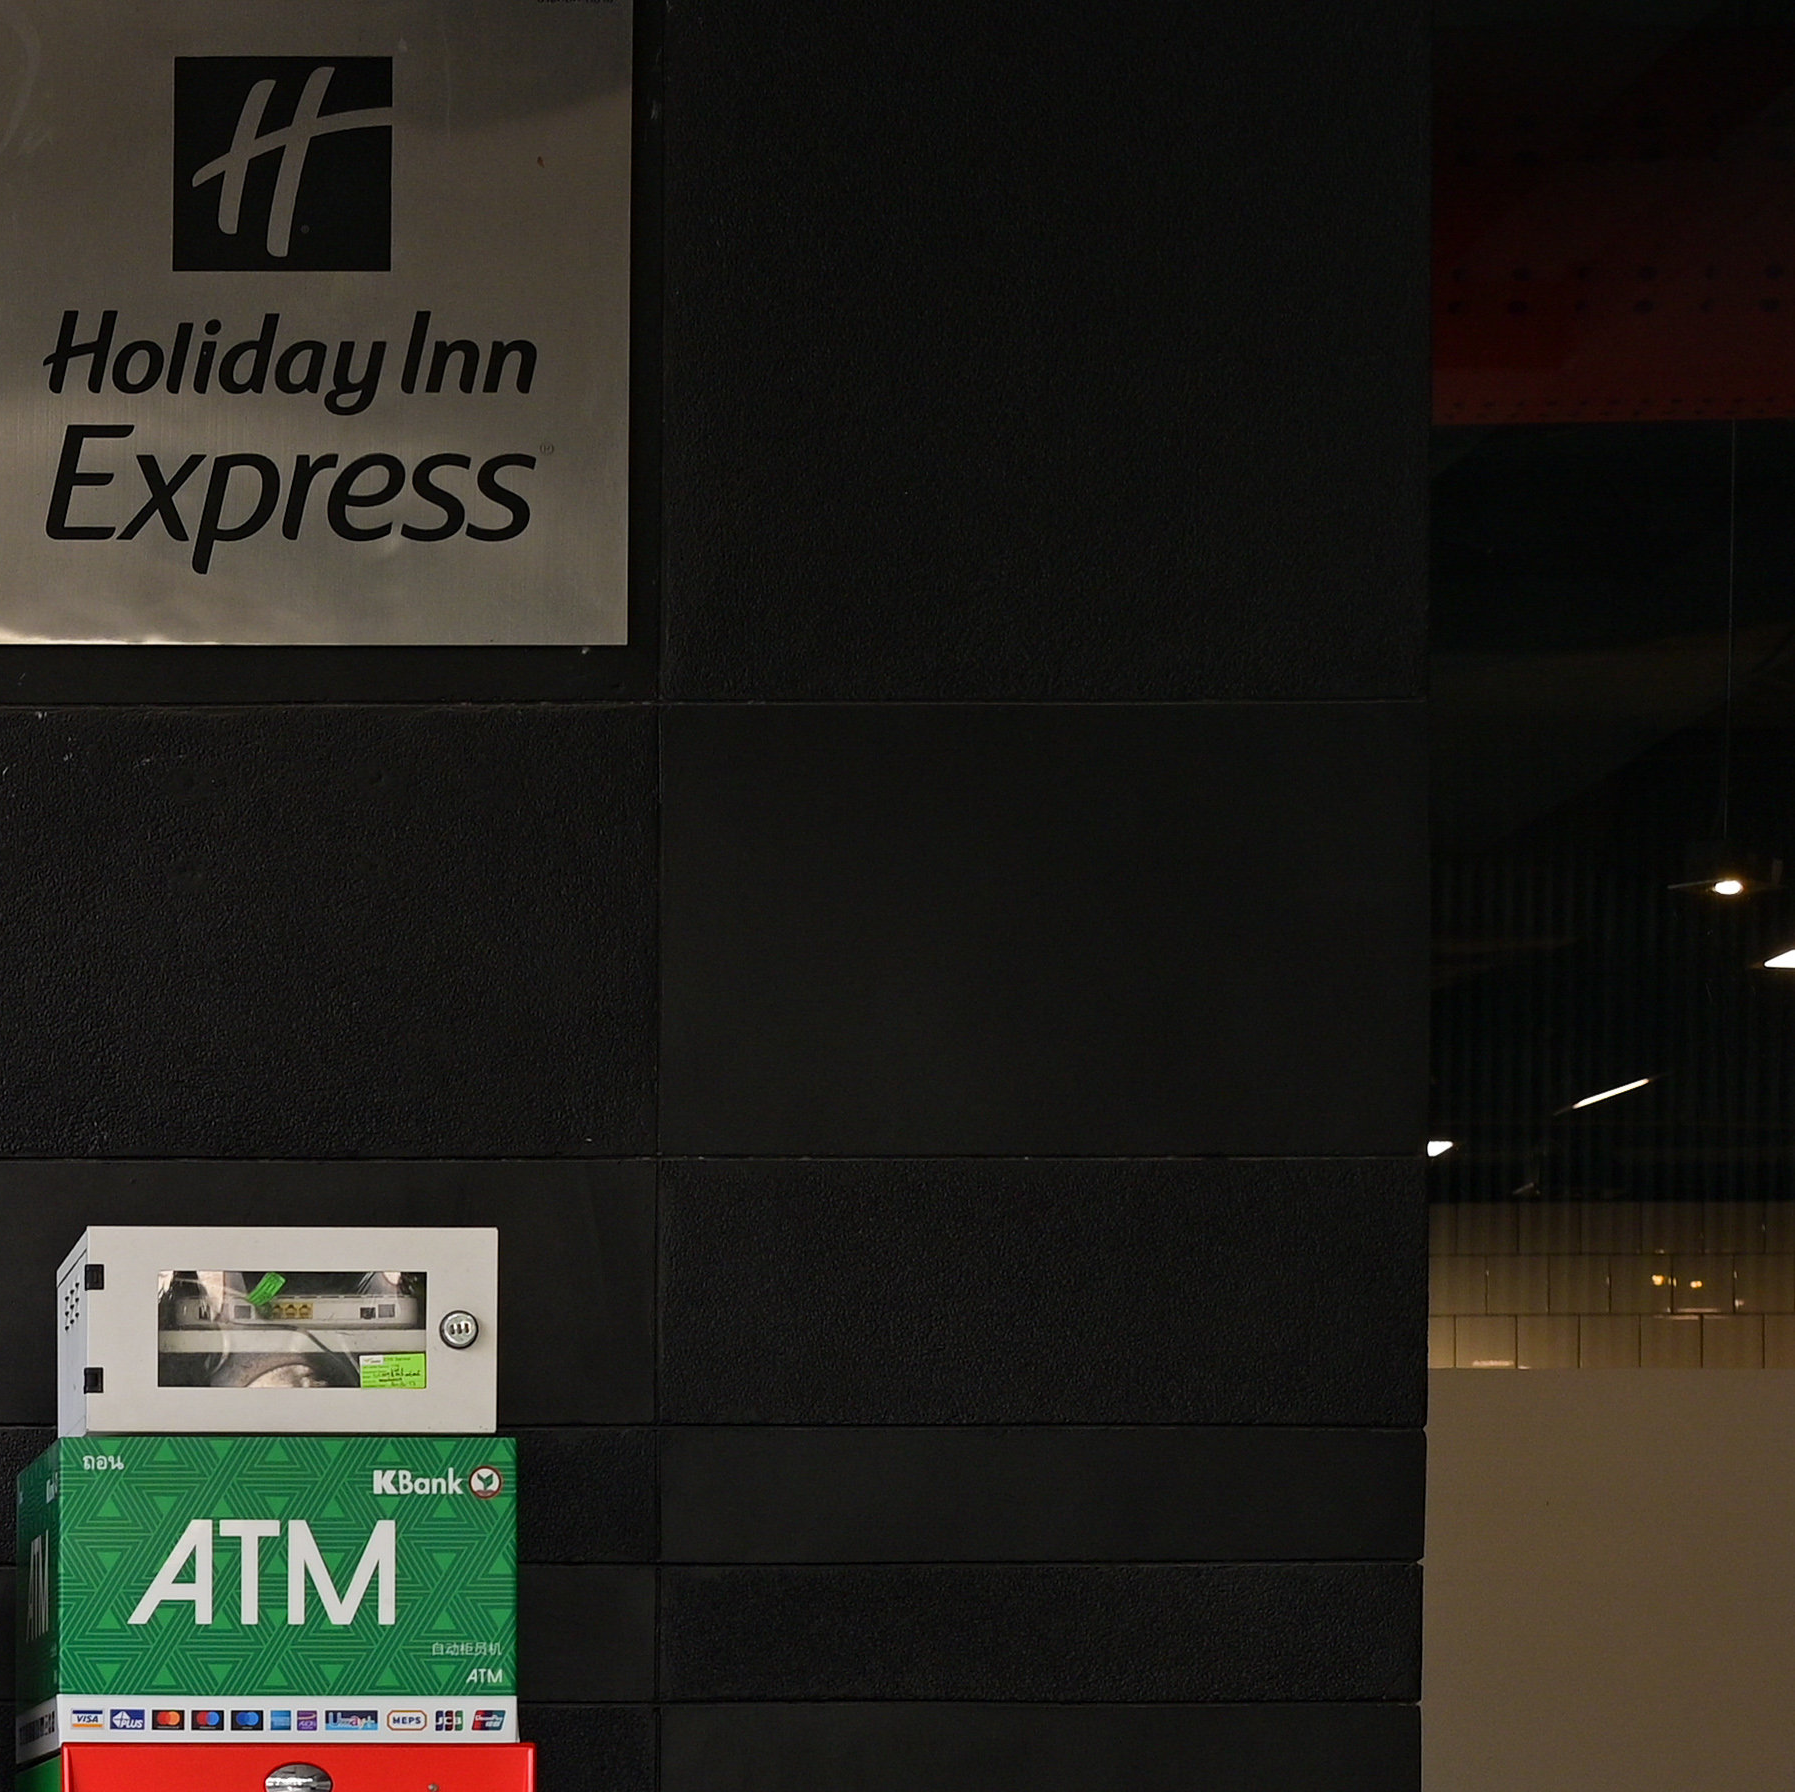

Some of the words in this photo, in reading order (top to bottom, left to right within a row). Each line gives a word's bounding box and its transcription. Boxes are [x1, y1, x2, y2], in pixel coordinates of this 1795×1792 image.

[43, 310, 387, 416] Holiday
[400, 310, 538, 394] Inn
[45, 424, 536, 575] Express
[83, 1455, 124, 1470] ถอน
[373, 1467, 463, 1494] KBank
[128, 1519, 396, 1625] ATM
[432, 1641, 502, 1656] 自动柜员机
[466, 1668, 503, 1683] ATM
[77, 1715, 99, 1724] VISA
[121, 1719, 143, 1729] PLUS
[436, 1717, 462, 1725] JCB
